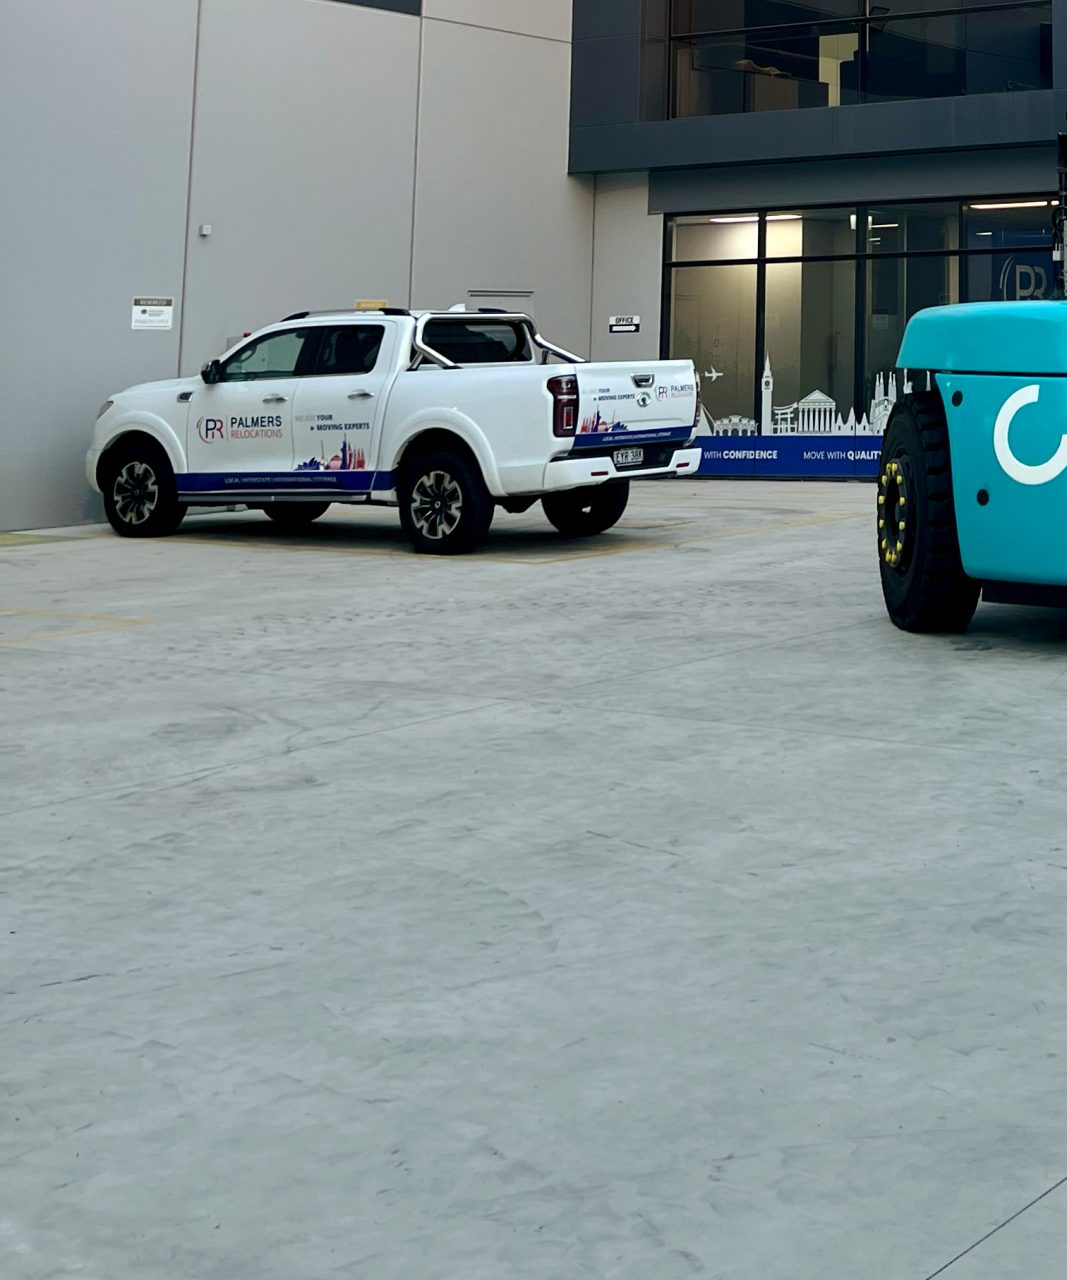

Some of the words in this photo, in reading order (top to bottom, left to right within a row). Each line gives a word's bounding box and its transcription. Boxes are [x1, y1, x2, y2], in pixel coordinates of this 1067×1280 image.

[205, 419, 224, 439] PR
[230, 415, 282, 428] PALMERS
[344, 422, 370, 430] EXPERTS
[230, 429, 283, 439] RELOCATIONS
[704, 451, 722, 459] WITH
[723, 450, 778, 459] CONFIDENCE
[803, 451, 825, 460] MOVE
[827, 451, 846, 459] WITH
